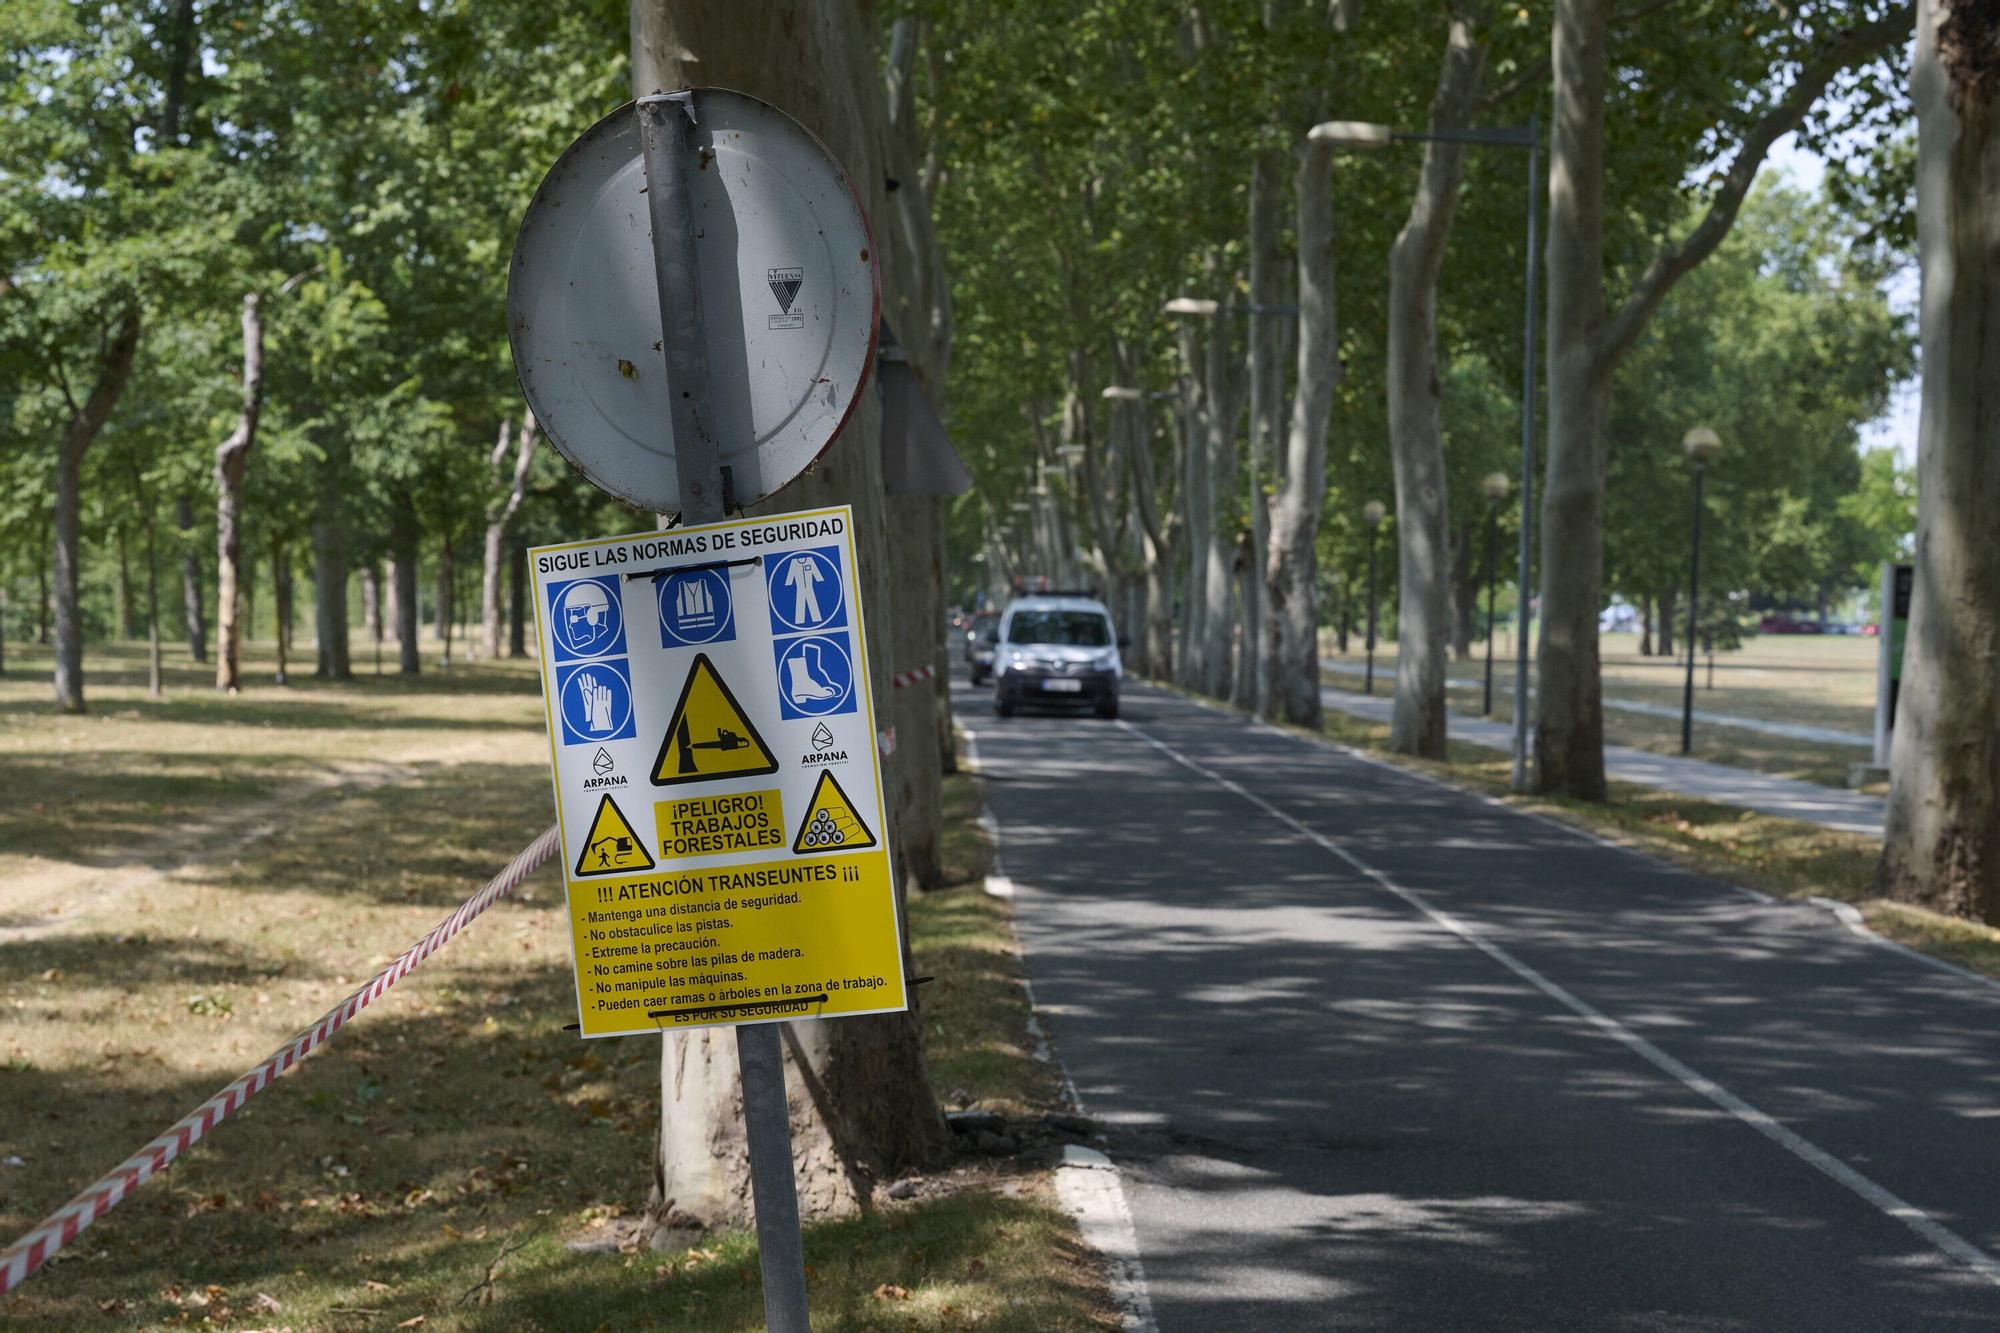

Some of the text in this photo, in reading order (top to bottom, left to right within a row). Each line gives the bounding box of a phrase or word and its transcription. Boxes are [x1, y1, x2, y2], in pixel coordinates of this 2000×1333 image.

[539, 518, 844, 573] SIGUE LAS NORMAS DE SEGURIDAD
[802, 751, 848, 764] ARPANA
[584, 776, 628, 788] ARPANA
[672, 795, 763, 819] ¡PELIGRO!
[671, 812, 768, 836] TRABAJOS
[663, 828, 781, 855] FORESTALES
[598, 887, 613, 903] !!!
[618, 875, 704, 901] ATENCIÓN
[708, 864, 837, 891] TRANSEUNTES
[588, 909, 642, 923] Mantenga
[646, 906, 666, 917] una
[670, 900, 720, 915] distancia
[724, 898, 738, 910] de
[742, 892, 802, 910] seguridad.
[590, 930, 606, 940] No
[609, 923, 673, 938] obstaculice
[676, 921, 692, 932] las
[696, 919, 733, 932] pistas.
[592, 945, 638, 958] Extreme
[641, 943, 651, 954] la
[654, 936, 720, 955] precaución.
[594, 964, 610, 976] No
[613, 961, 653, 973] camine
[656, 958, 688, 970] sobre
[692, 956, 708, 966] las
[711, 953, 738, 967] pilas
[741, 951, 755, 962] de
[758, 947, 804, 961] madera.
[596, 982, 612, 994] No
[615, 977, 666, 992] manipule
[669, 976, 686, 986] las
[689, 971, 747, 986] máquinas.
[598, 998, 640, 1012] Pueden
[644, 996, 668, 1007] caer
[671, 993, 705, 1005] ramas
[708, 992, 715, 1001] o
[720, 987, 761, 1000] árboles
[764, 987, 778, 996] en
[781, 984, 791, 995] la
[795, 982, 822, 994] zona
[826, 979, 840, 991] de
[843, 976, 888, 989] trabajo.
[675, 1001, 809, 1022] ES POR SU SEGURIDAD
